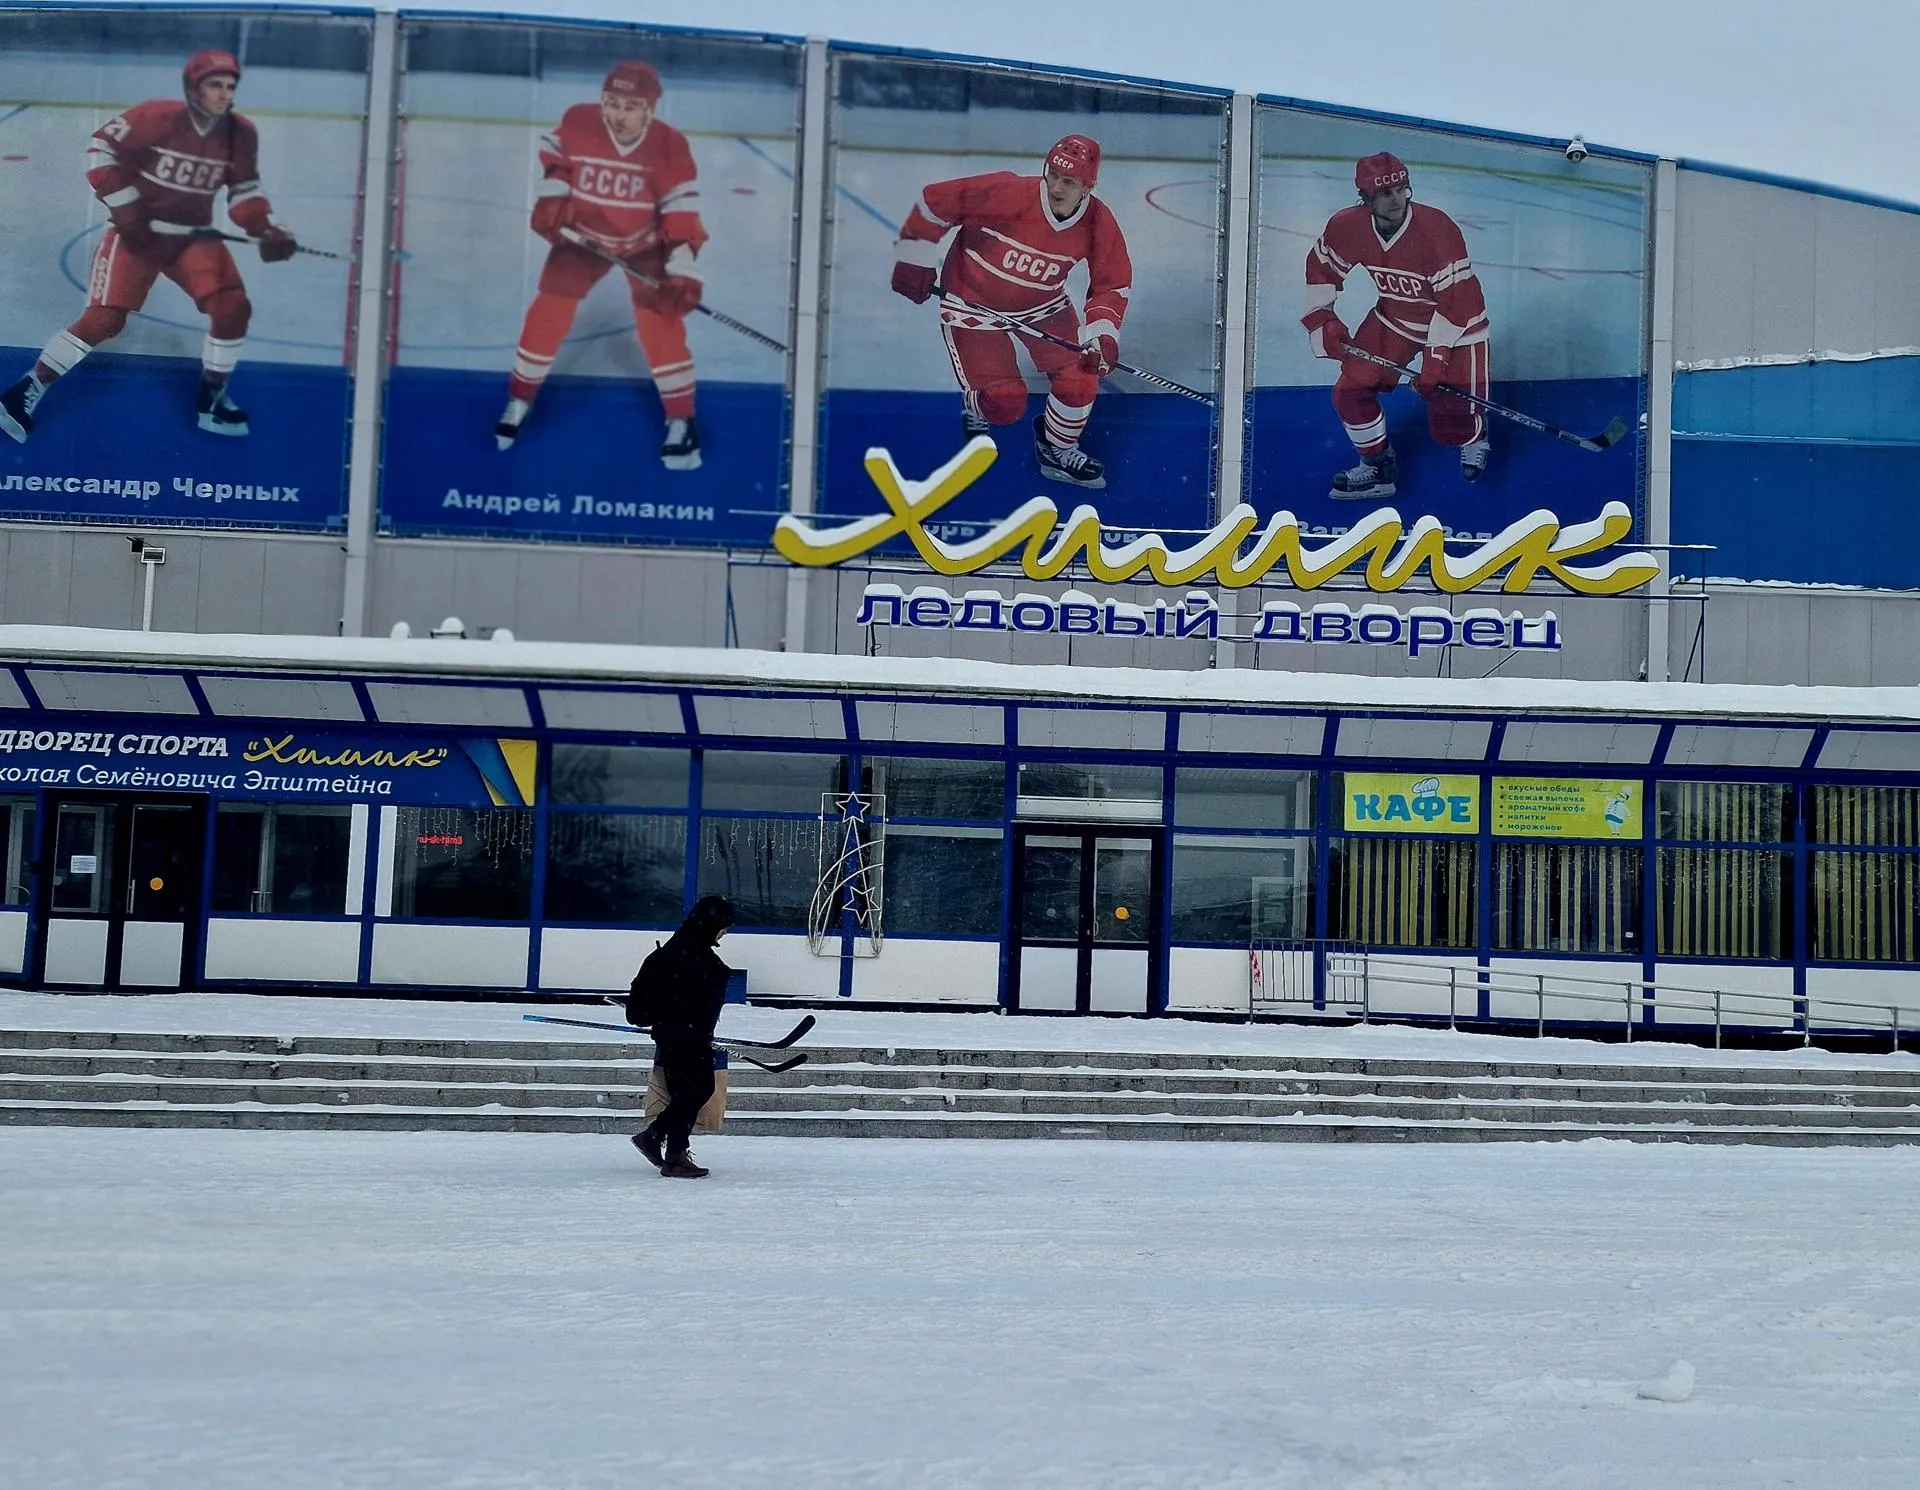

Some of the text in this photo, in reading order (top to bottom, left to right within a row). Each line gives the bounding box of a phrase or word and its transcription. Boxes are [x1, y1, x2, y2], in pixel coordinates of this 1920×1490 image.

[156, 155, 225, 188] СССР
[1053, 155, 1074, 170] СССР
[579, 166, 645, 198] СССР
[1374, 170, 1407, 187] СССР
[1002, 249, 1061, 282] СССР
[1374, 271, 1423, 297] СССР
[0, 474, 300, 503] лександр Черных
[442, 488, 715, 521] Андрей Ломакин
[774, 438, 1661, 598] Химик
[855, 590, 1563, 660] ледовый дворец
[0, 729, 115, 757] ДВОРЕЦ
[118, 734, 229, 757] СПОРТА
[76, 764, 237, 789] Семёновича
[243, 769, 393, 795] Эпштейна
[1508, 785, 1580, 794] вкусные обеды
[1353, 793, 1472, 823] КАФЕ
[1508, 794, 1585, 803] свежая выпечка
[1563, 804, 1586, 813] кофе
[1508, 824, 1562, 832] мороженое
